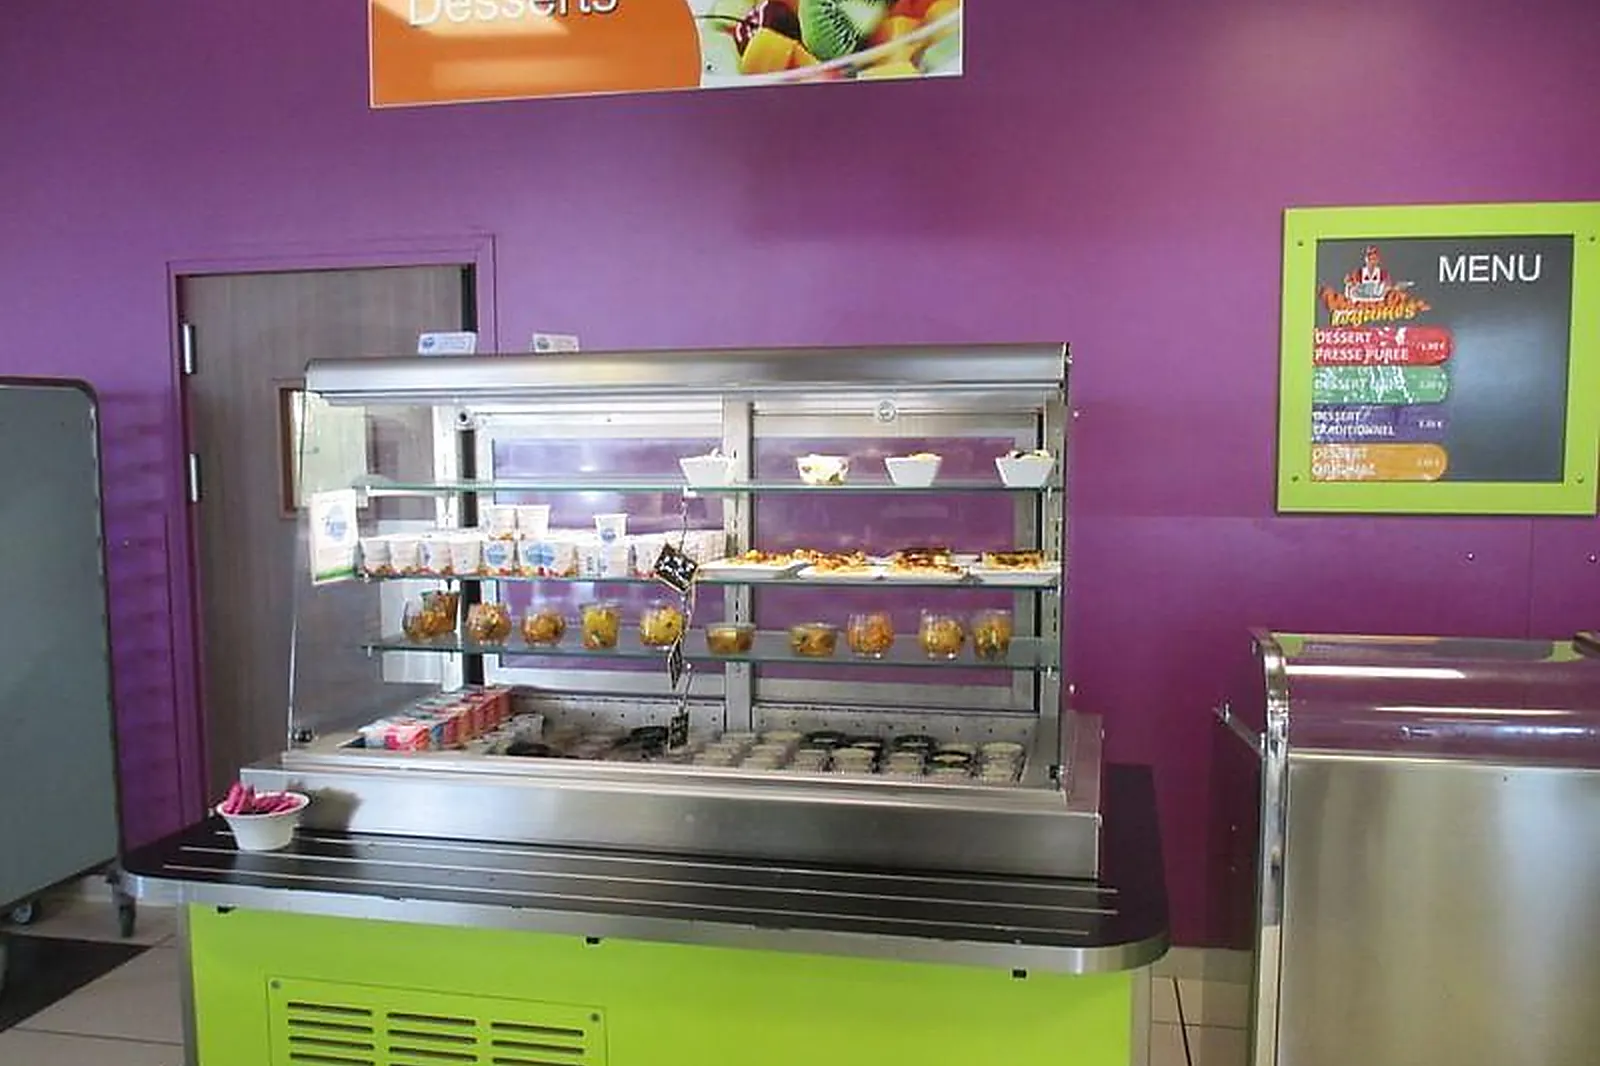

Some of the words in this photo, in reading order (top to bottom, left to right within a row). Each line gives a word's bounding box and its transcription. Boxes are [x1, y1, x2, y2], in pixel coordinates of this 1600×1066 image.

[1439, 254, 1541, 282] MENU
[1314, 330, 1373, 344] DESSERT
[1315, 347, 1363, 361] PRESSE
